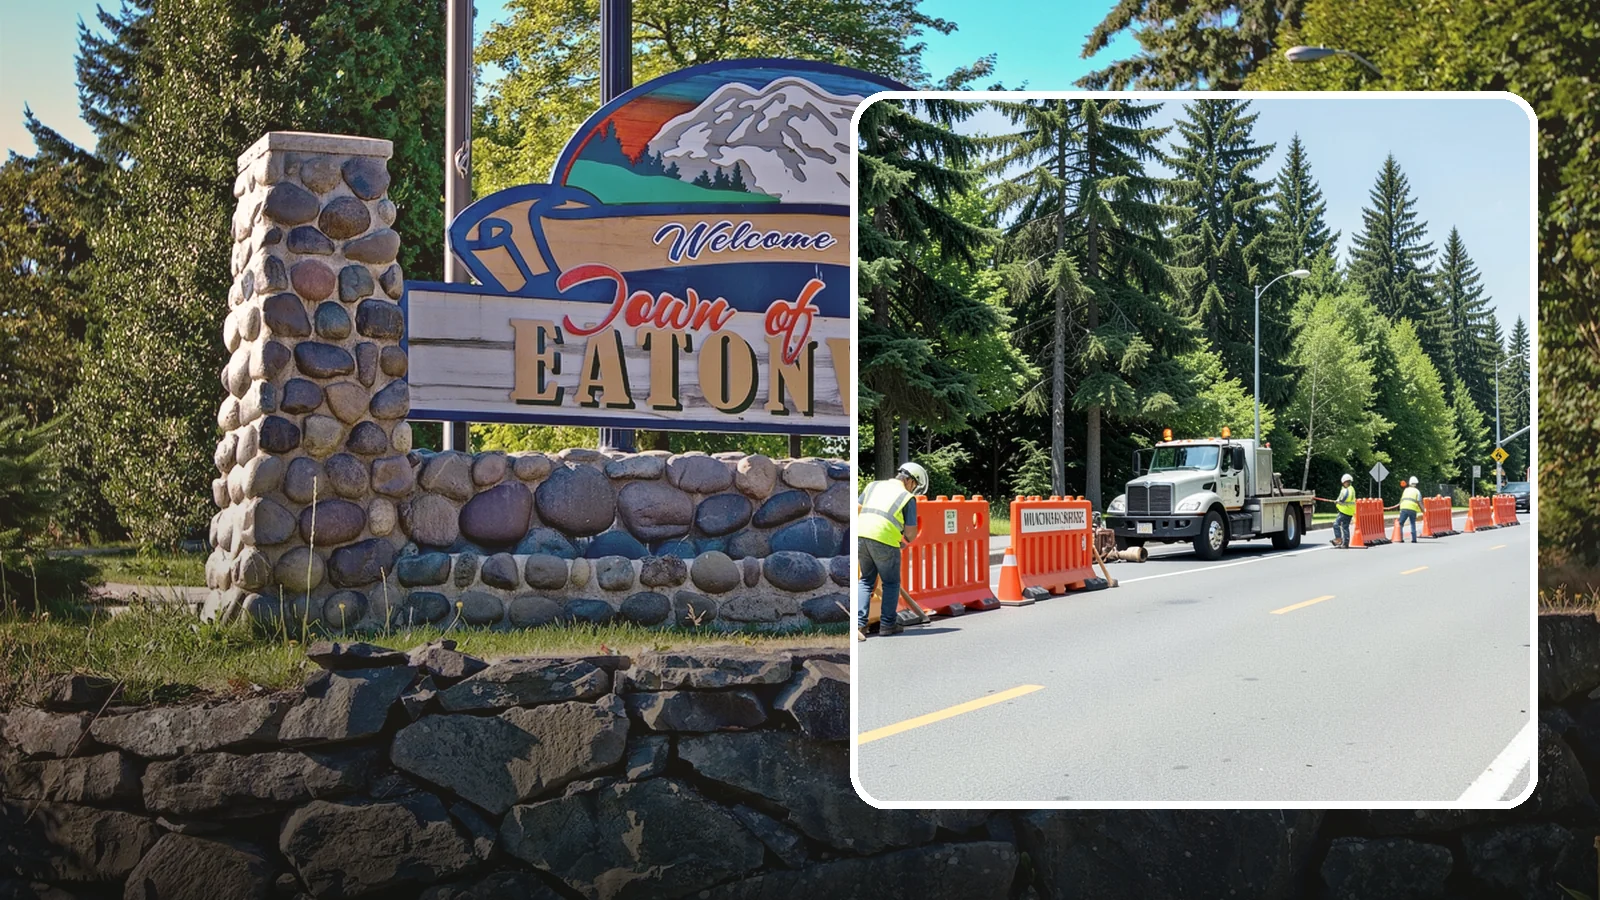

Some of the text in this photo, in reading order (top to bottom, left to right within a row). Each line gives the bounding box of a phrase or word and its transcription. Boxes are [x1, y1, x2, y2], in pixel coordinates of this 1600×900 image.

[654, 221, 836, 263] Welcome
[557, 264, 826, 364] Town of
